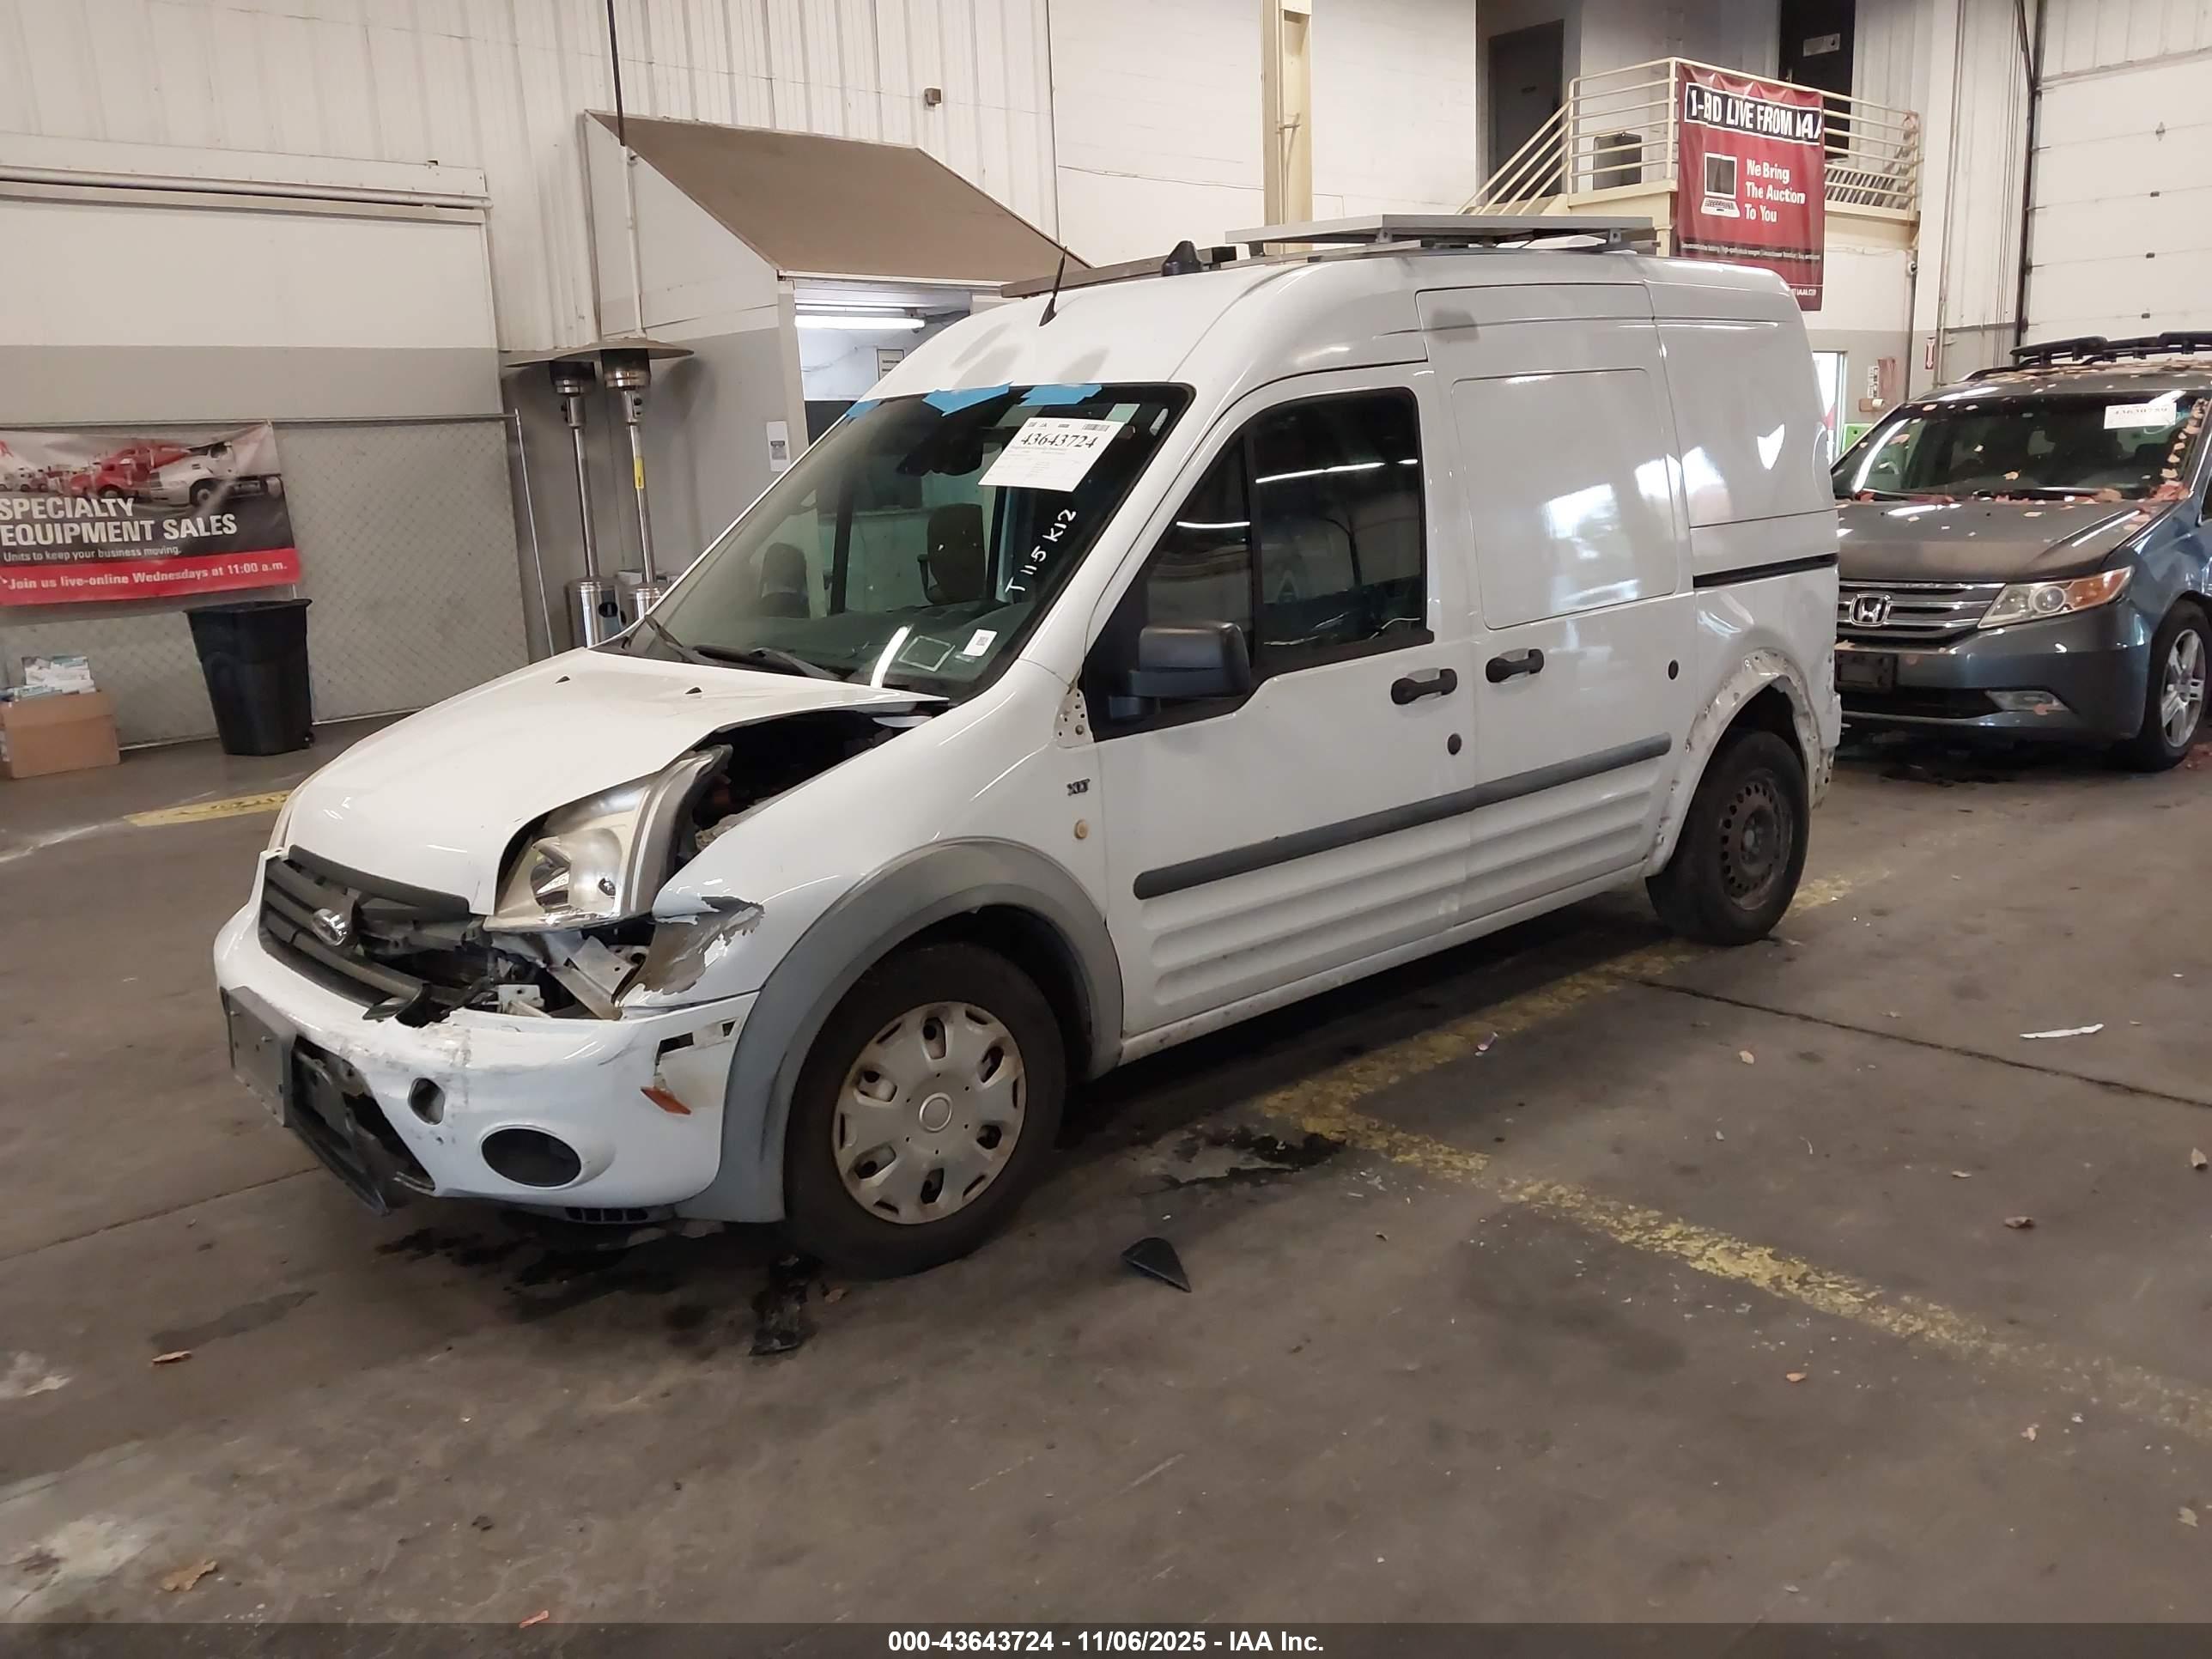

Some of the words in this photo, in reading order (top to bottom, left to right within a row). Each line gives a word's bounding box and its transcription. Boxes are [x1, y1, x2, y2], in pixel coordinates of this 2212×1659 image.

[1726, 98, 1755, 130] LIVE
[1757, 105, 1793, 137] FROM
[1763, 161, 1790, 185] Bring
[1745, 180, 1764, 199] The
[1765, 184, 1806, 204] Auction
[1744, 203, 1757, 221] To
[1759, 204, 1778, 222] You
[1020, 431, 1098, 448] 43643724
[0, 496, 135, 520] SPECIALTY
[0, 520, 155, 547] EQUIPMENT
[162, 513, 238, 540] SALES
[1042, 508, 1077, 543] K12
[3, 551, 31, 562] Units
[33, 551, 43, 562] to
[45, 550, 70, 562] keep
[72, 549, 96, 561] your
[98, 547, 142, 558] business
[143, 545, 182, 557] moving.
[8, 578, 37, 590] Join
[40, 578, 57, 588] us
[60, 574, 129, 587] live-online
[132, 568, 209, 585] Wednesdays
[211, 565, 223, 576] at
[227, 562, 258, 574] 11:00
[261, 561, 289, 573] a.m.
